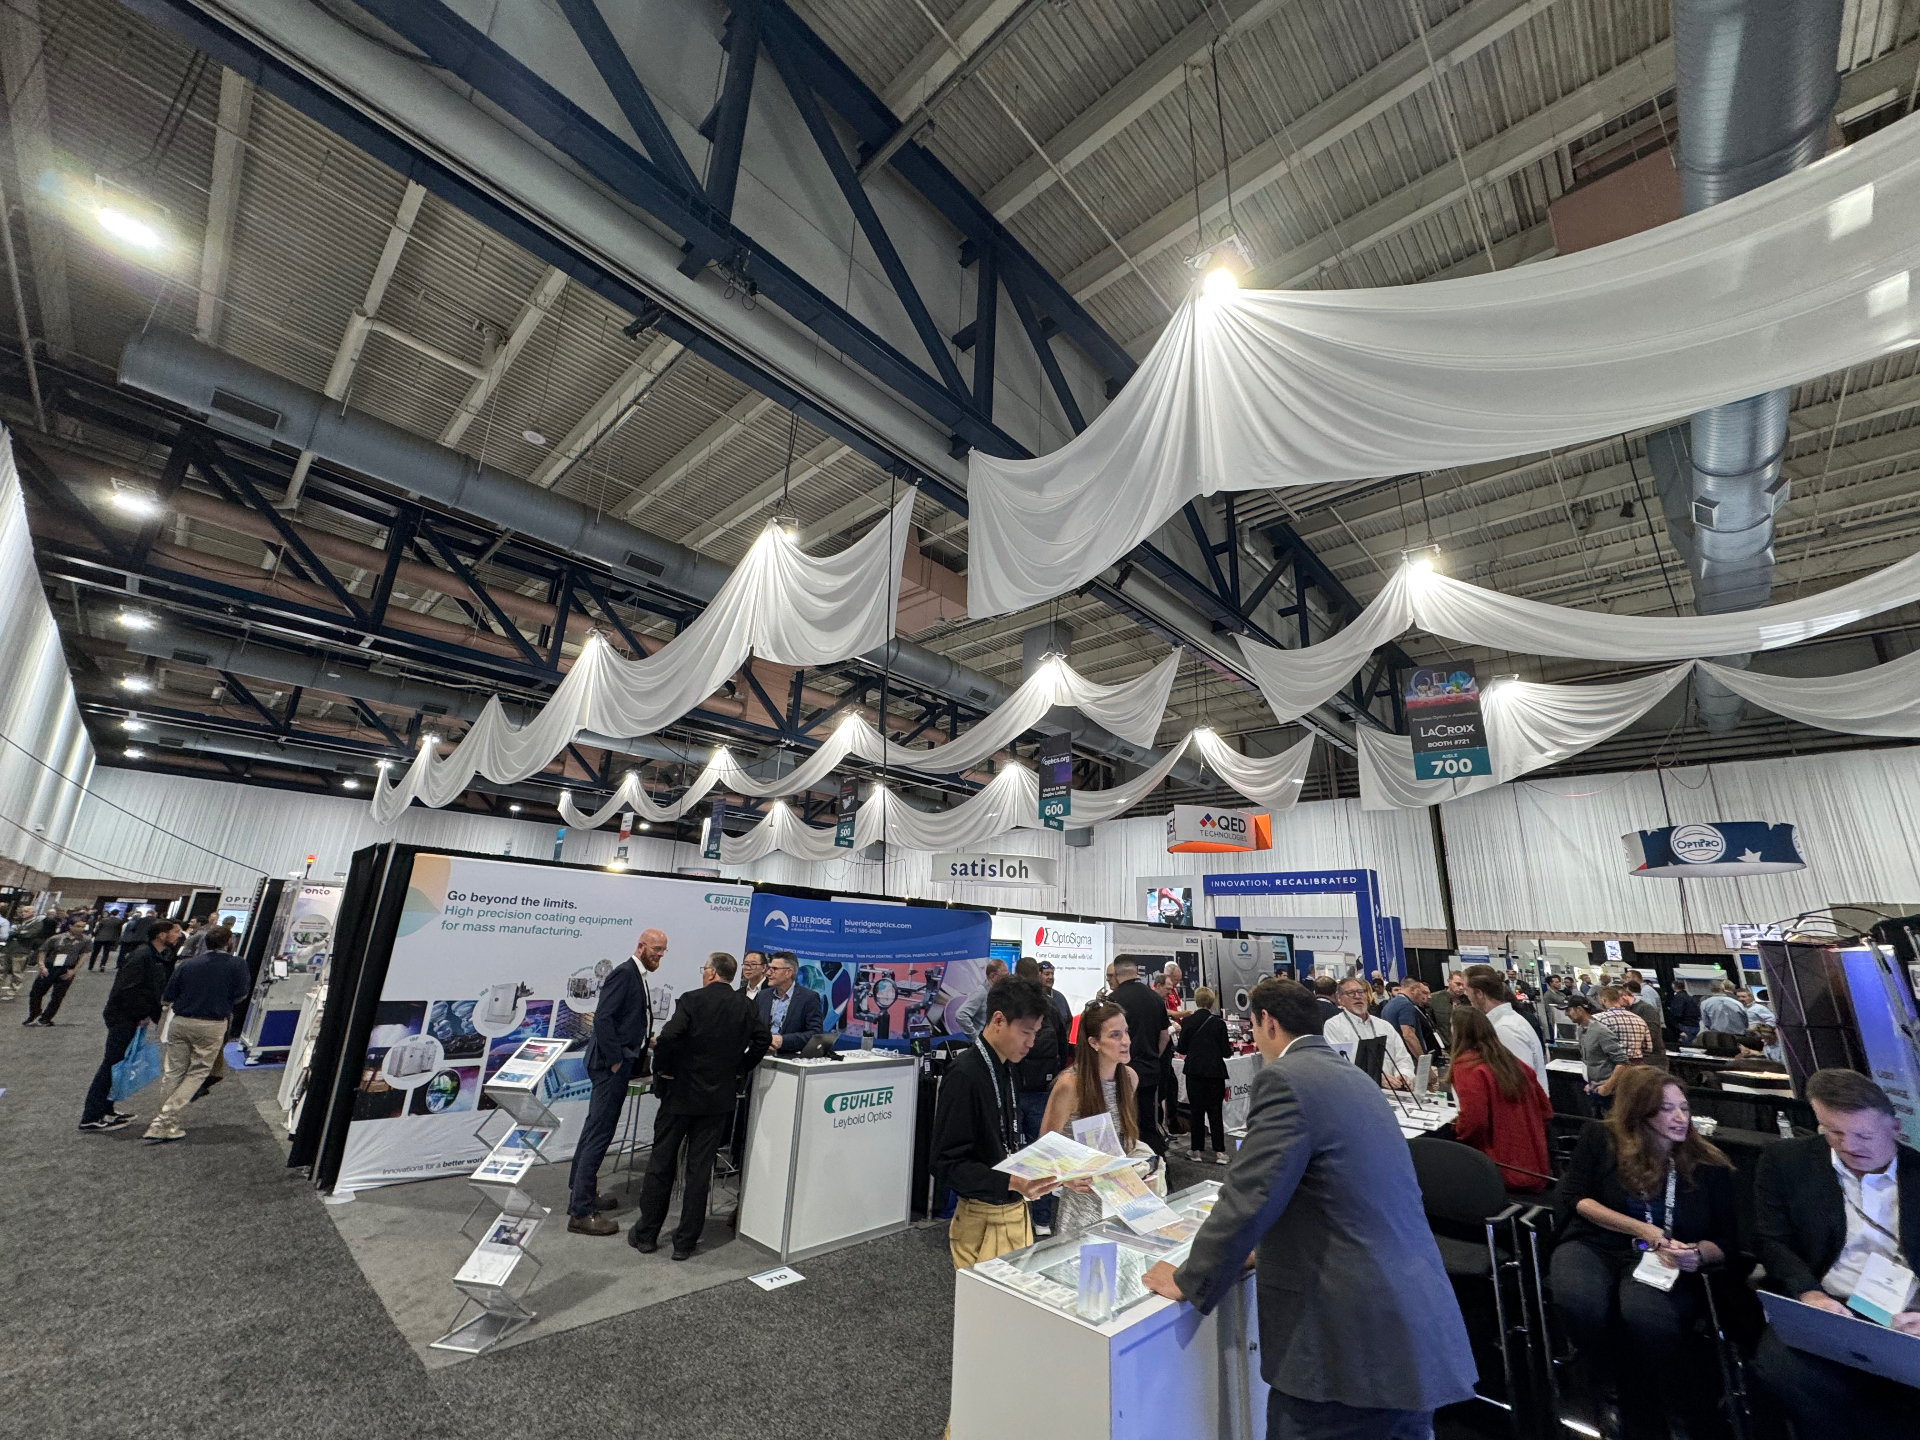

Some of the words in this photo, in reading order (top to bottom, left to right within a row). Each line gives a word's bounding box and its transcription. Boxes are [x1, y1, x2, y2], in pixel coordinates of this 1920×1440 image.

[1431, 758, 1472, 776] 700
[1045, 804, 1063, 816] 600
[840, 828, 851, 837] 500
[1218, 816, 1246, 833] QED
[1200, 830, 1247, 842] TECHNOLOGIES
[951, 858, 1028, 878] satisloh
[1211, 880, 1271, 888] INNOVATION,
[1275, 877, 1357, 886] RECALIBRATED
[447, 891, 466, 901] Go
[471, 893, 517, 905] beyond
[521, 896, 540, 906] the
[544, 898, 578, 909] limits.
[714, 897, 750, 906] BÜHLER
[444, 905, 473, 918] High
[477, 908, 531, 920] precision
[535, 912, 575, 924] coating
[578, 915, 633, 927] equipment
[845, 919, 912, 929] blueridgeoptics.com
[441, 921, 459, 930] for
[463, 923, 495, 932] mass
[499, 923, 583, 938] manufacturing.
[1052, 931, 1092, 947] OptoSigma
[839, 1090, 893, 1111] BÜHLER
[834, 1114, 865, 1129] Leybold
[867, 1110, 892, 1123] Optics
[382, 1165, 423, 1175] Innovations
[442, 1159, 465, 1167] better
[766, 1274, 788, 1283] 710
